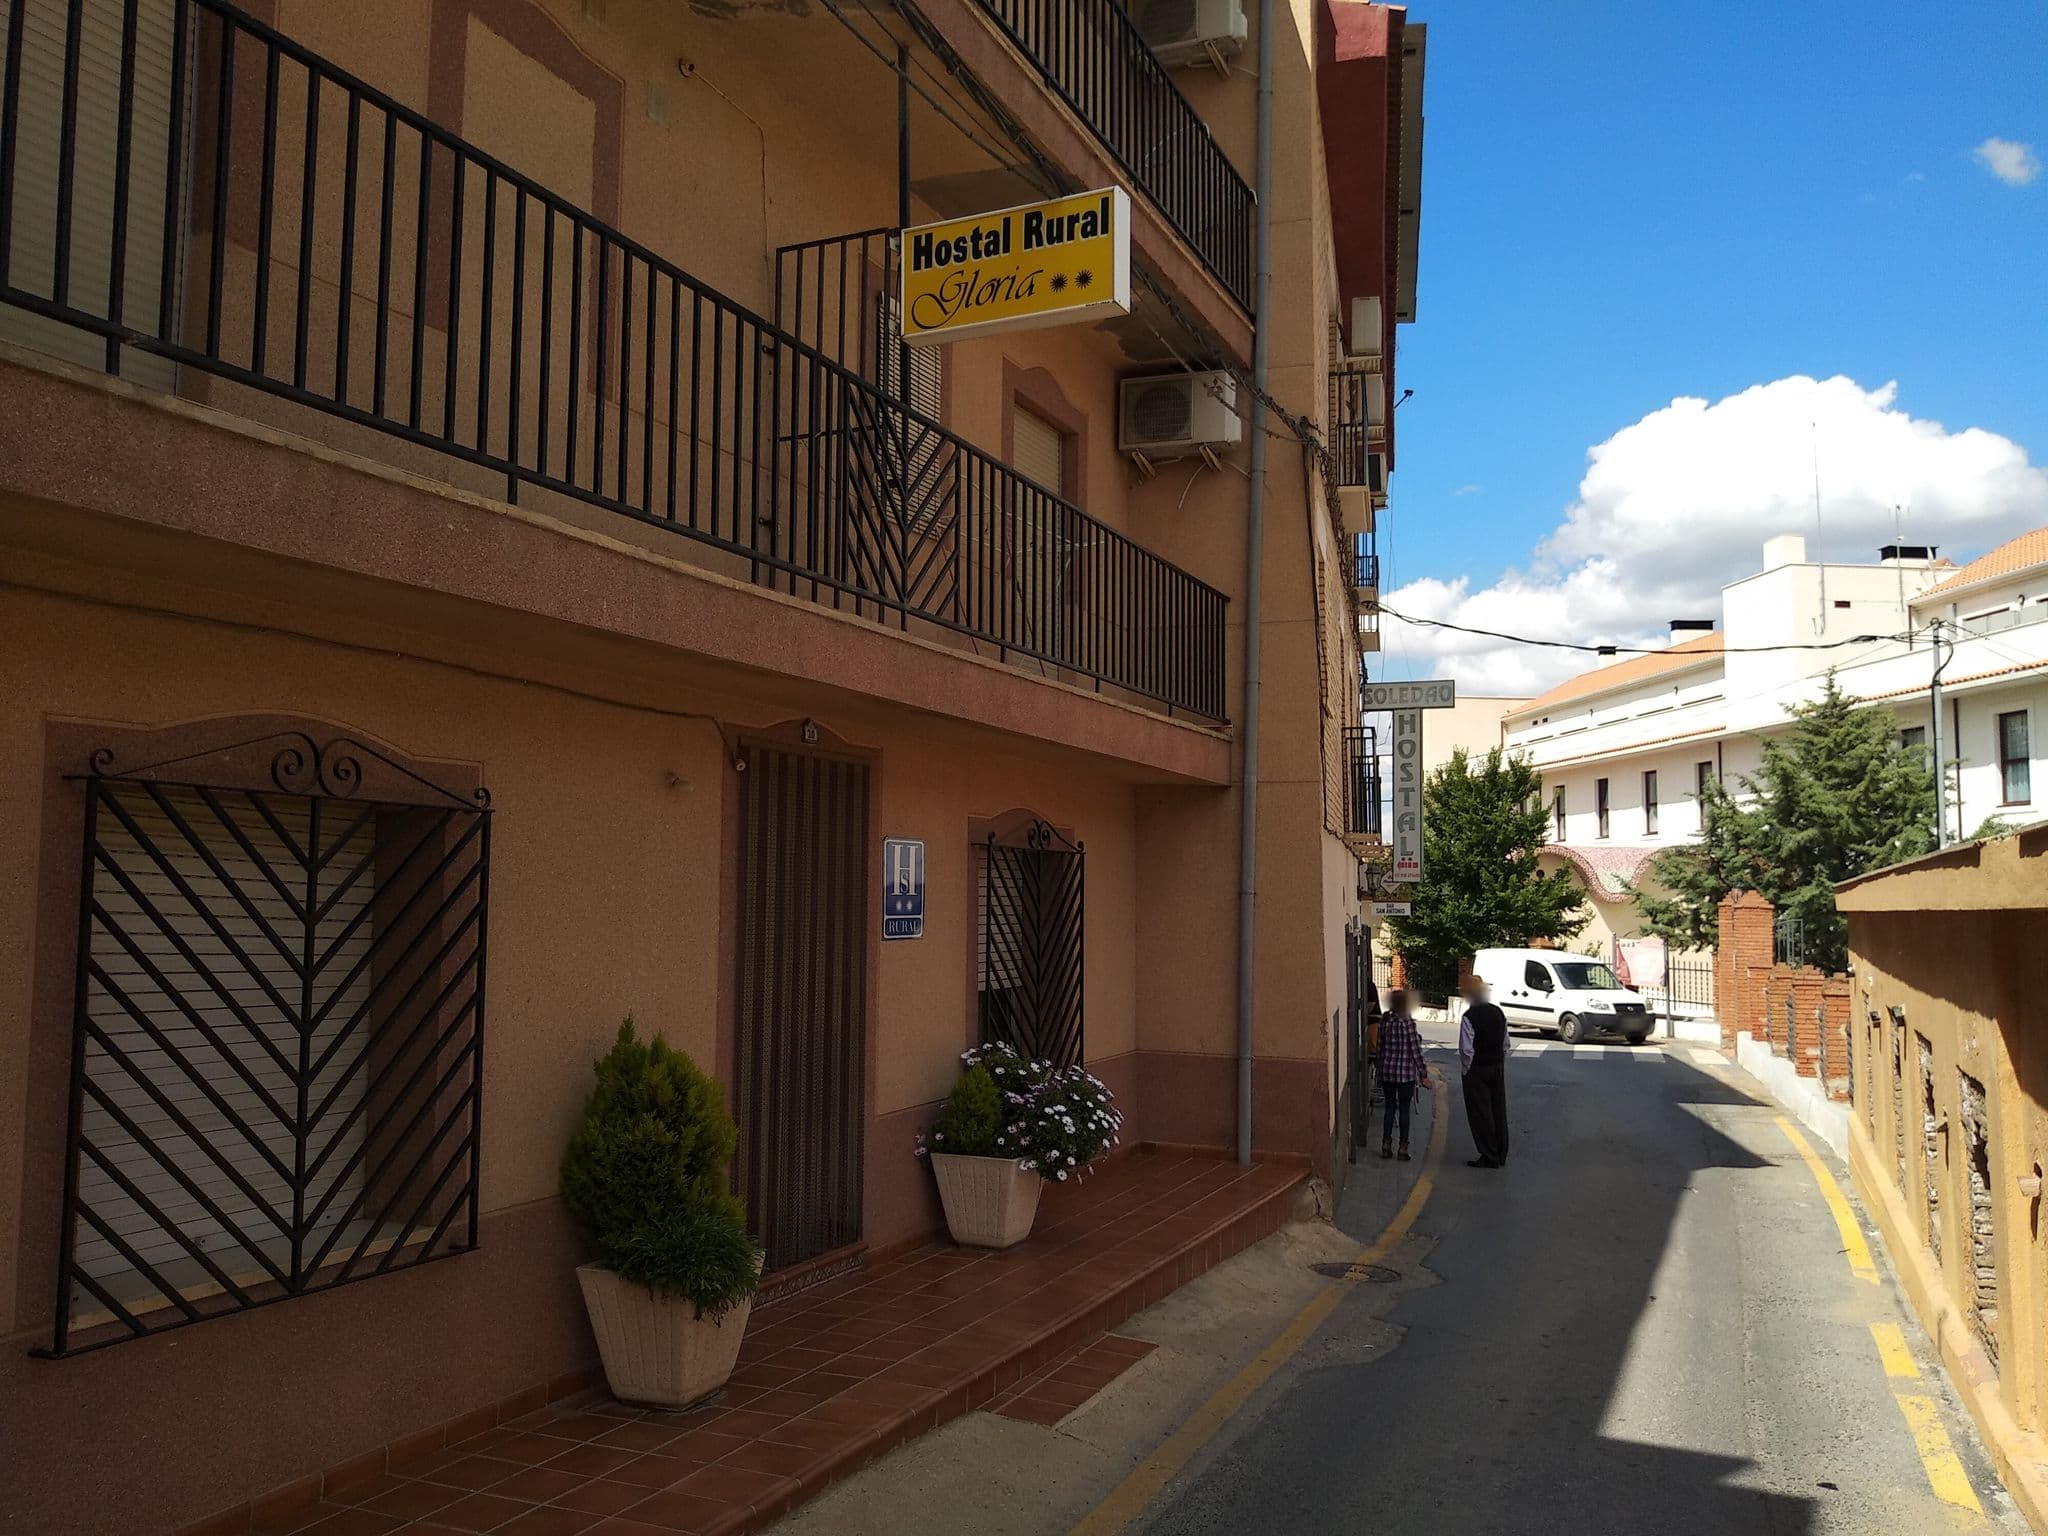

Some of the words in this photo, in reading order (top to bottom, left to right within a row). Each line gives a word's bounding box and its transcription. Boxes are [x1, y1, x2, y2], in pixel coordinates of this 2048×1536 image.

[912, 217, 1011, 271] Hostal
[1023, 197, 1110, 250] Rural
[911, 265, 1044, 330] Gloria
[1396, 714, 1417, 857] HOSTAL
[888, 920, 920, 934] RURAL
